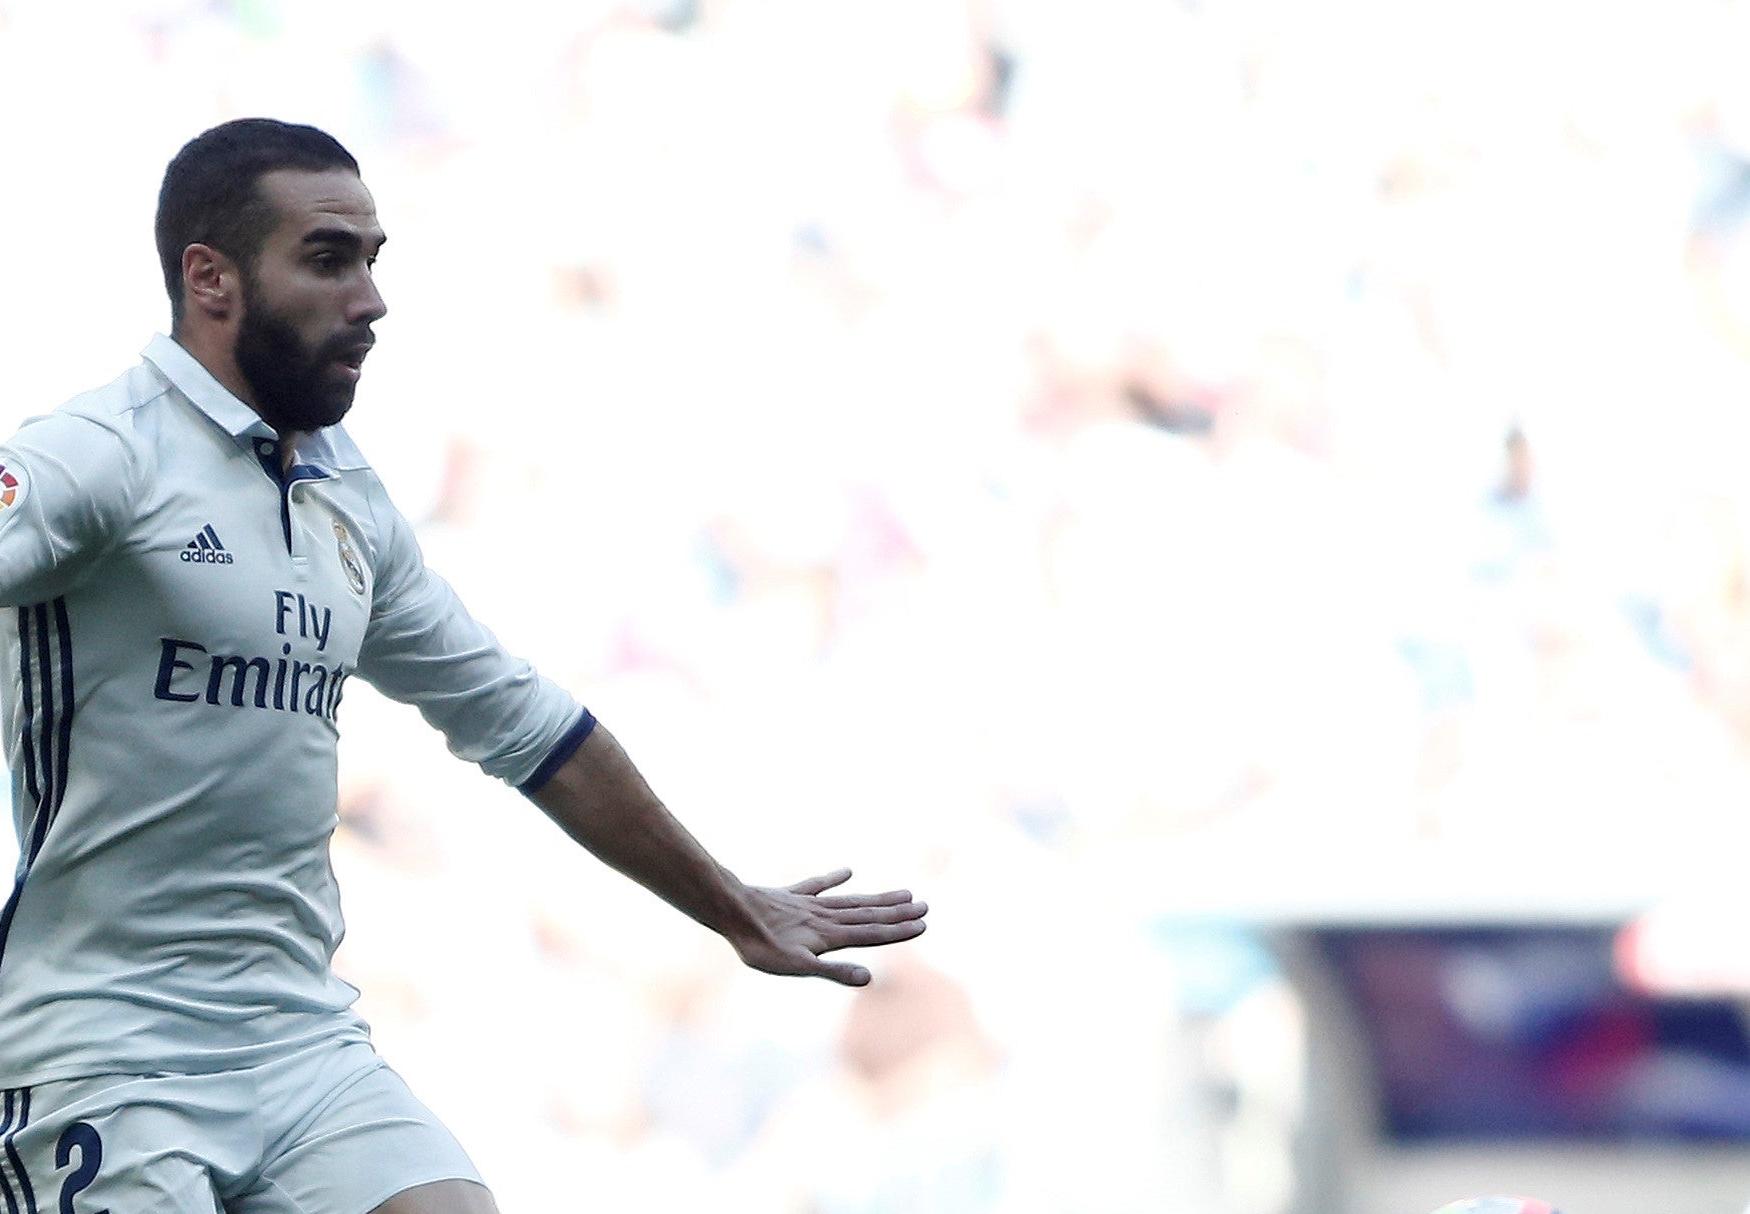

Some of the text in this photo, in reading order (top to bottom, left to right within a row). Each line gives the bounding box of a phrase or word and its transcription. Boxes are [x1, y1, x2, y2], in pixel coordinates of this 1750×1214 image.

[180, 549, 234, 564] adidas
[274, 589, 331, 652] Fly
[154, 637, 346, 720] Emirat
